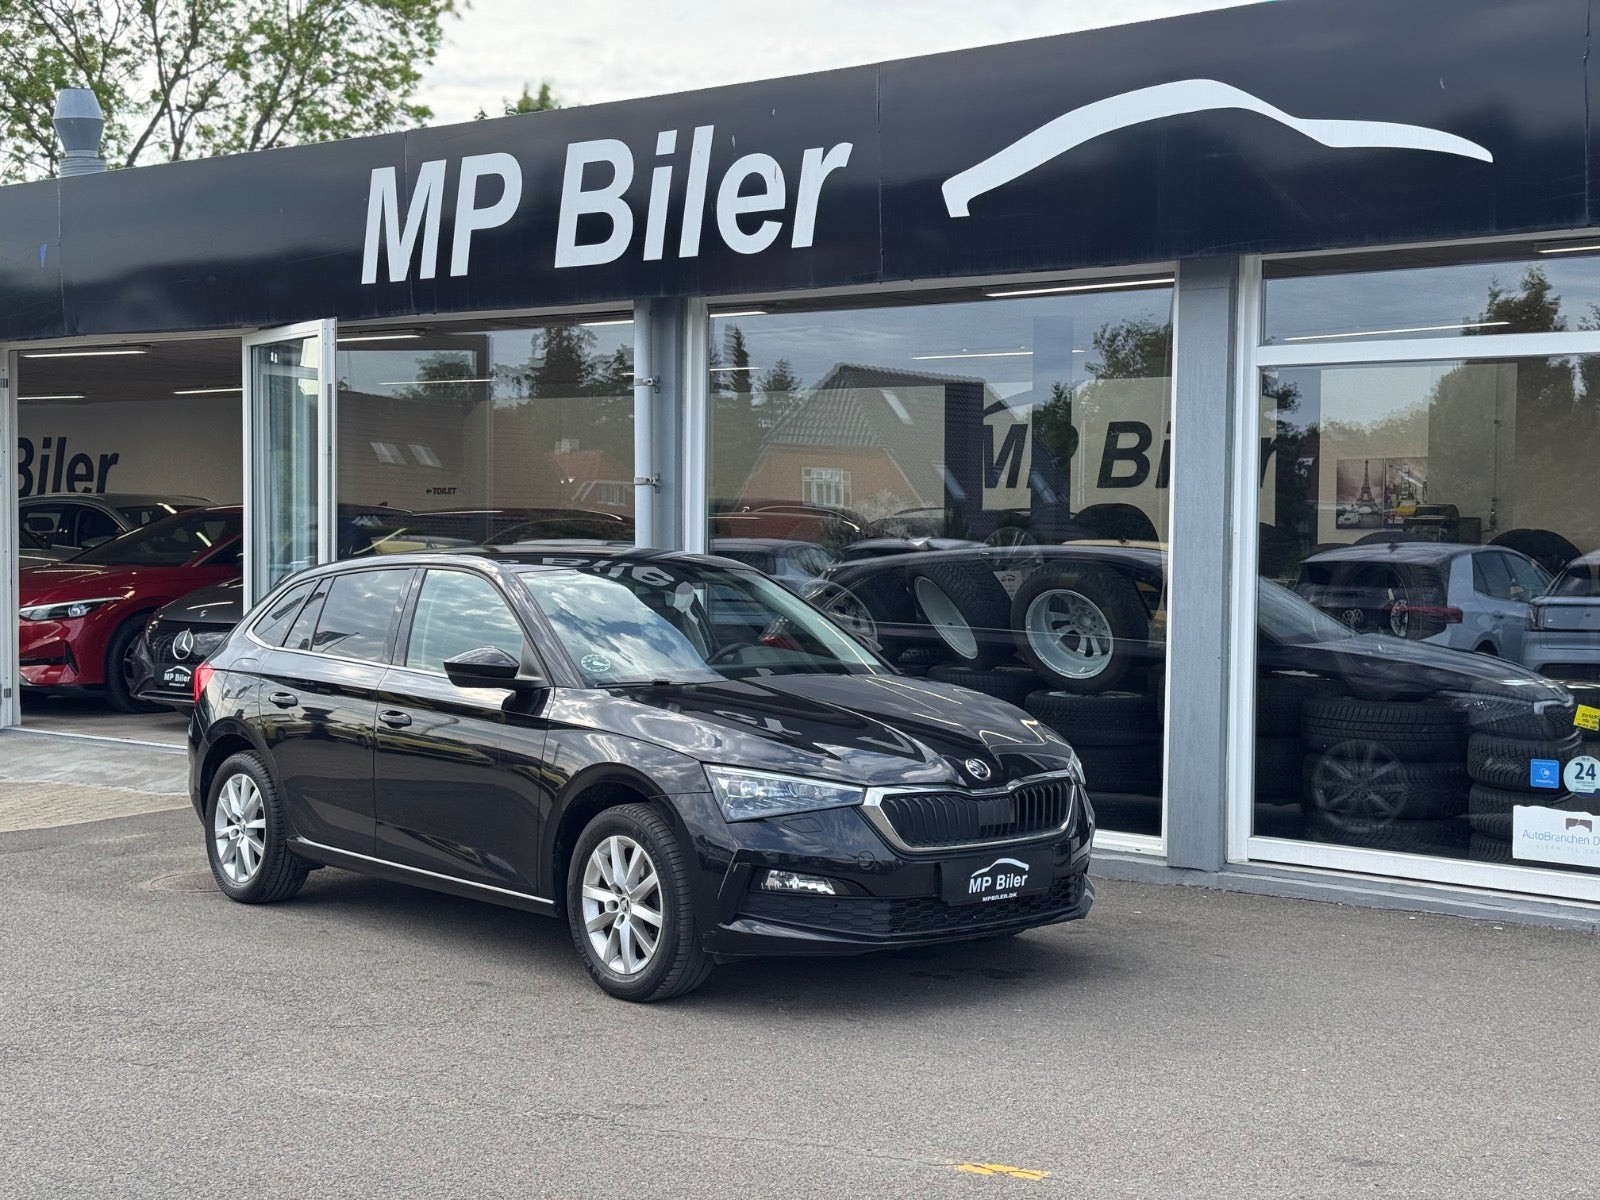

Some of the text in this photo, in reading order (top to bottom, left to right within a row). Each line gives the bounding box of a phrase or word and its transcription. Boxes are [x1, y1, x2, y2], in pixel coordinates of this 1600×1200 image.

[360, 125, 853, 285] MP Biler
[164, 673, 191, 682] MP Biler
[1574, 762, 1597, 781] 24
[1522, 829, 1600, 846] AutoBranchen D
[968, 873, 1028, 894] MP Biler
